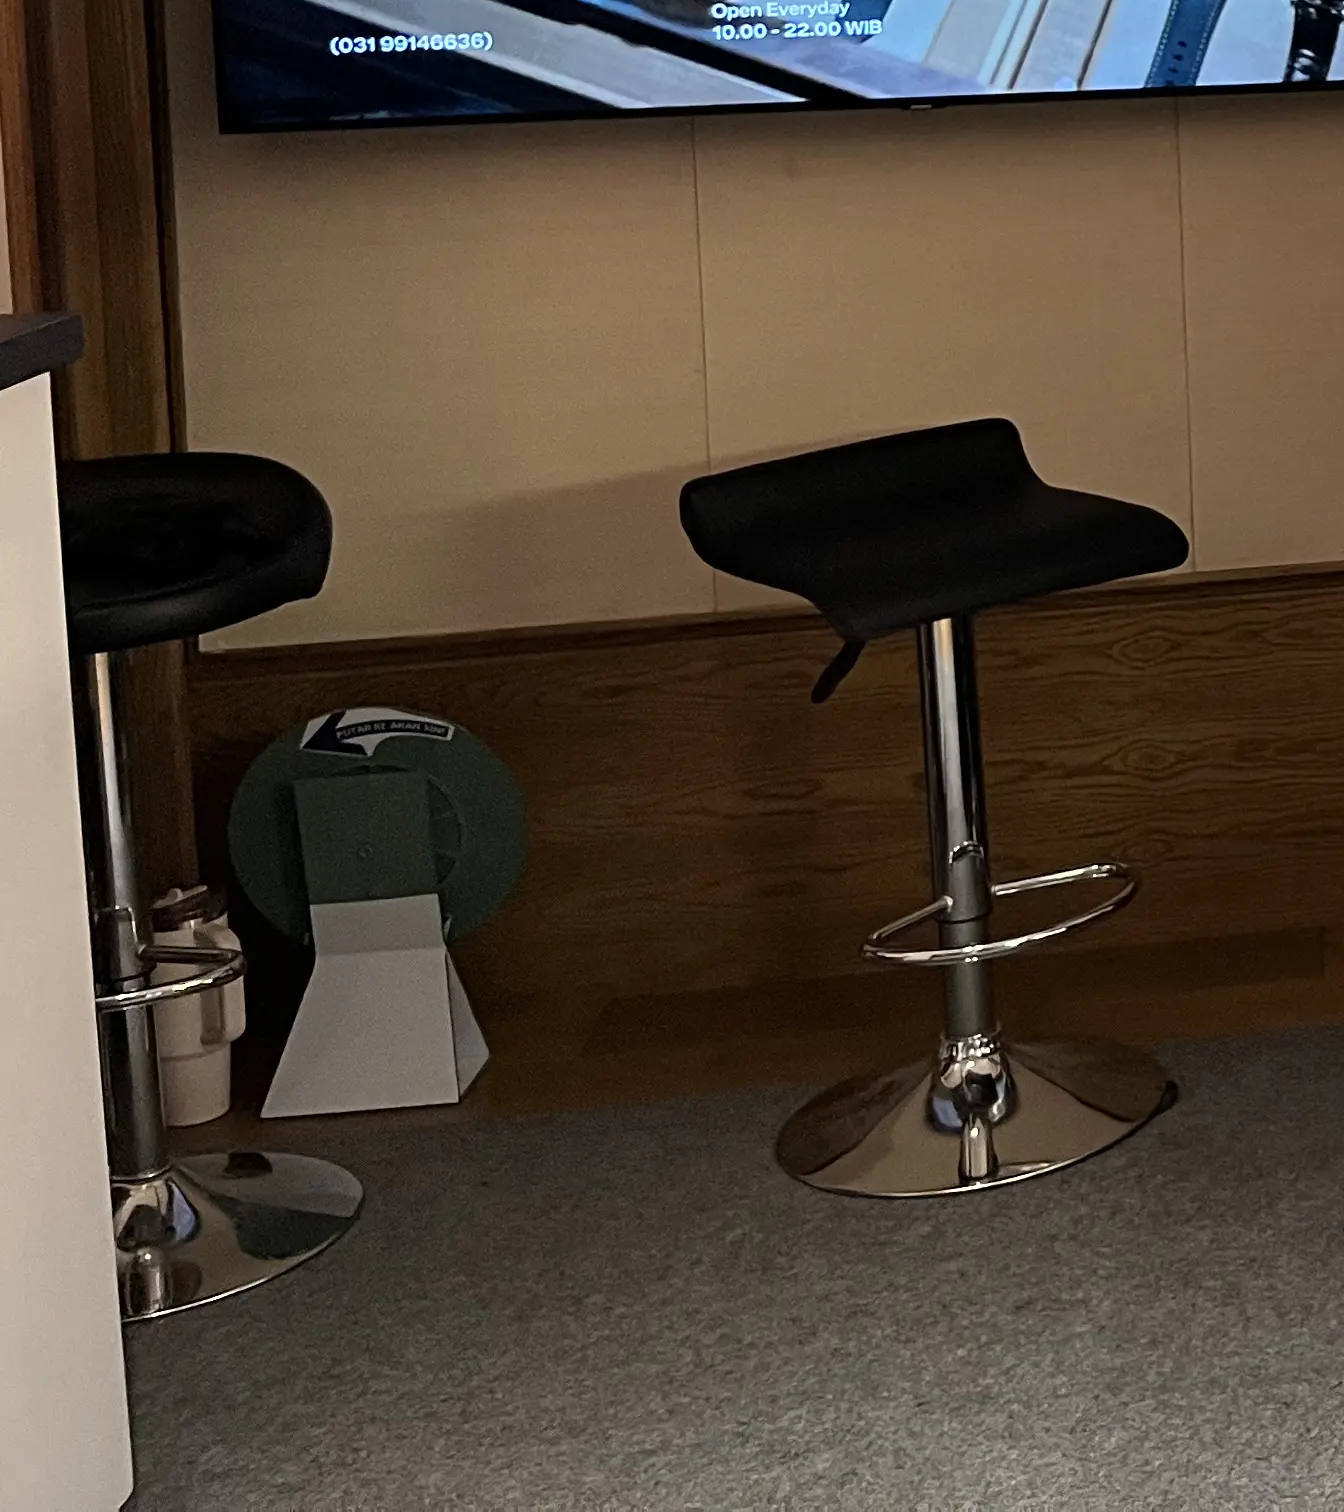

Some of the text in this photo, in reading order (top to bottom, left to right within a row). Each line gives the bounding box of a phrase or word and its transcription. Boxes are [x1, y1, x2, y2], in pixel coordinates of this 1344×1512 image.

[711, 1, 850, 21] Open Everyday
[712, 23, 768, 40] 10.00
[784, 21, 842, 38] 22.00
[845, 19, 883, 35] WIB
[329, 32, 493, 56] (031 99146636)
